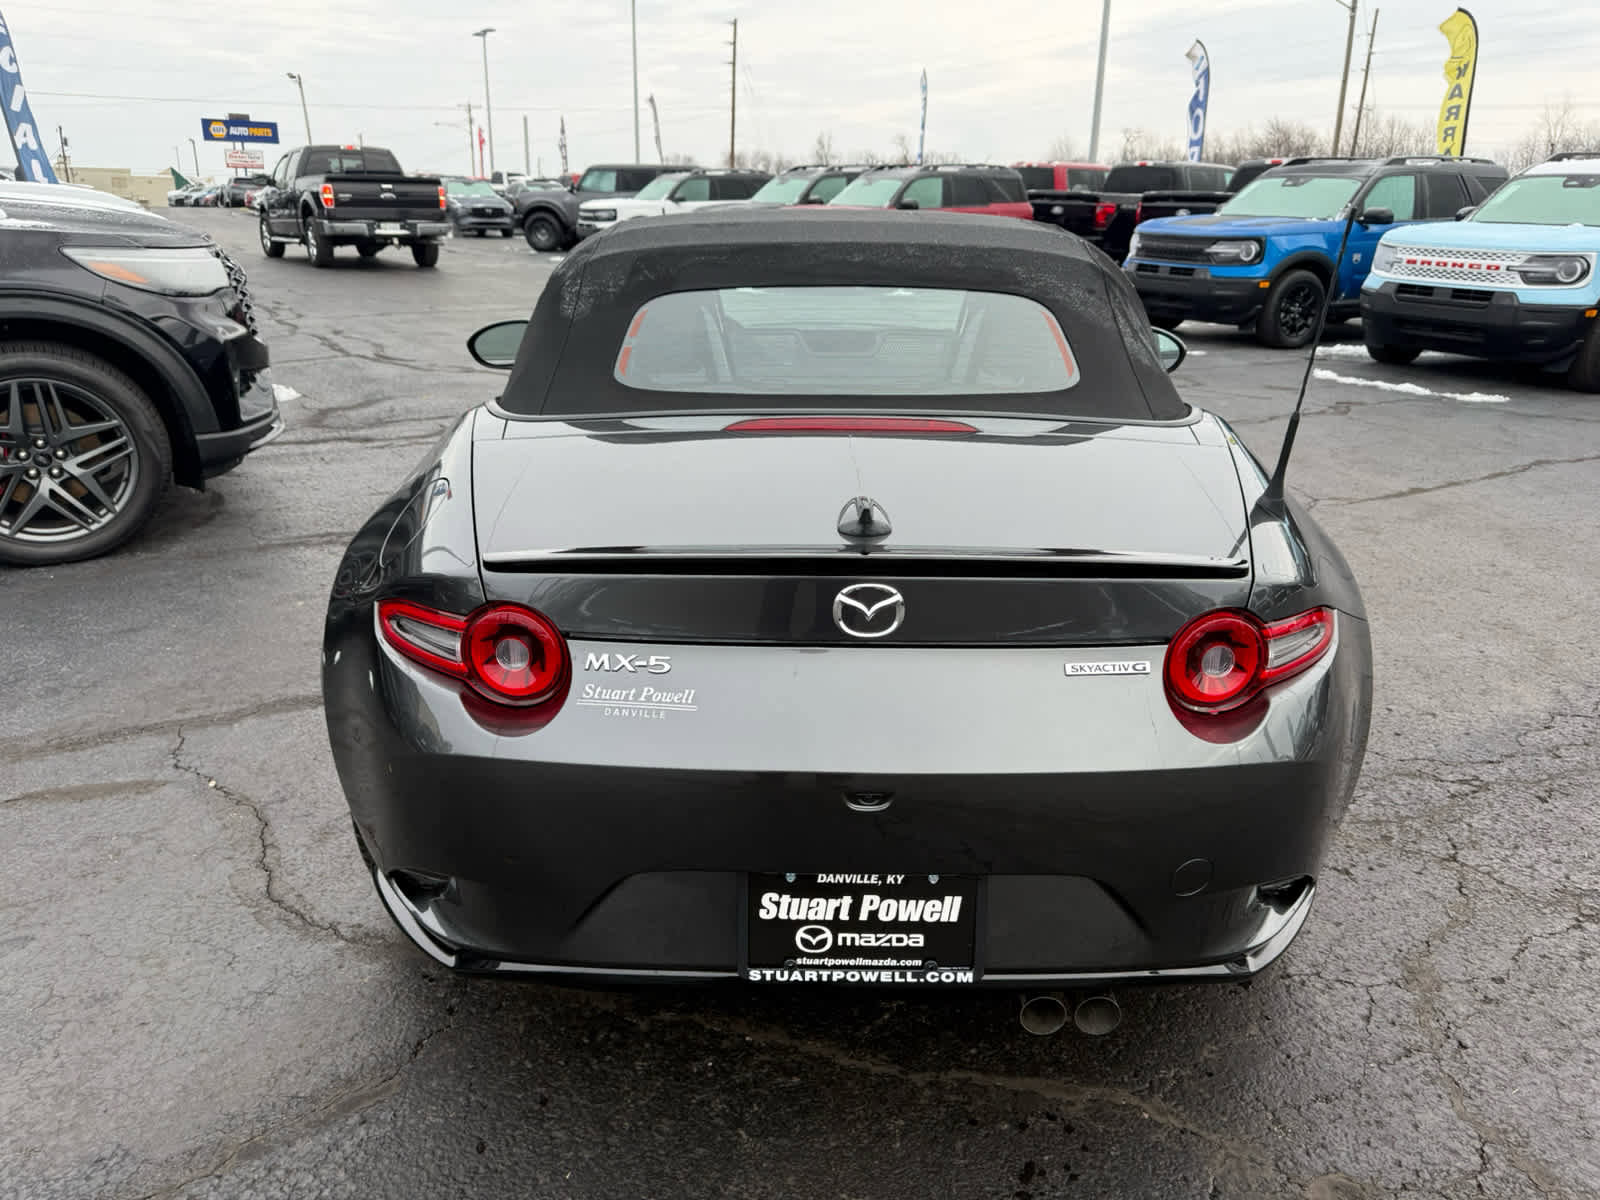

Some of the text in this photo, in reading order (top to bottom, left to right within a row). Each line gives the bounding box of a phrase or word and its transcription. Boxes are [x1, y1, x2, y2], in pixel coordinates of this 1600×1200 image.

[229, 126, 248, 136] AUTO
[1405, 258, 1500, 271] BRONCO
[584, 652, 671, 674] MX-5
[582, 683, 695, 703] Stuart Powell
[604, 707, 665, 719] DANVILLE
[817, 873, 905, 886] DANVILLE, KY
[759, 892, 962, 923] Stuart Powell
[837, 933, 925, 947] mazda
[796, 957, 922, 967] stuartpowellmazda.com
[749, 969, 974, 983] STUARTPOWELL.COM
